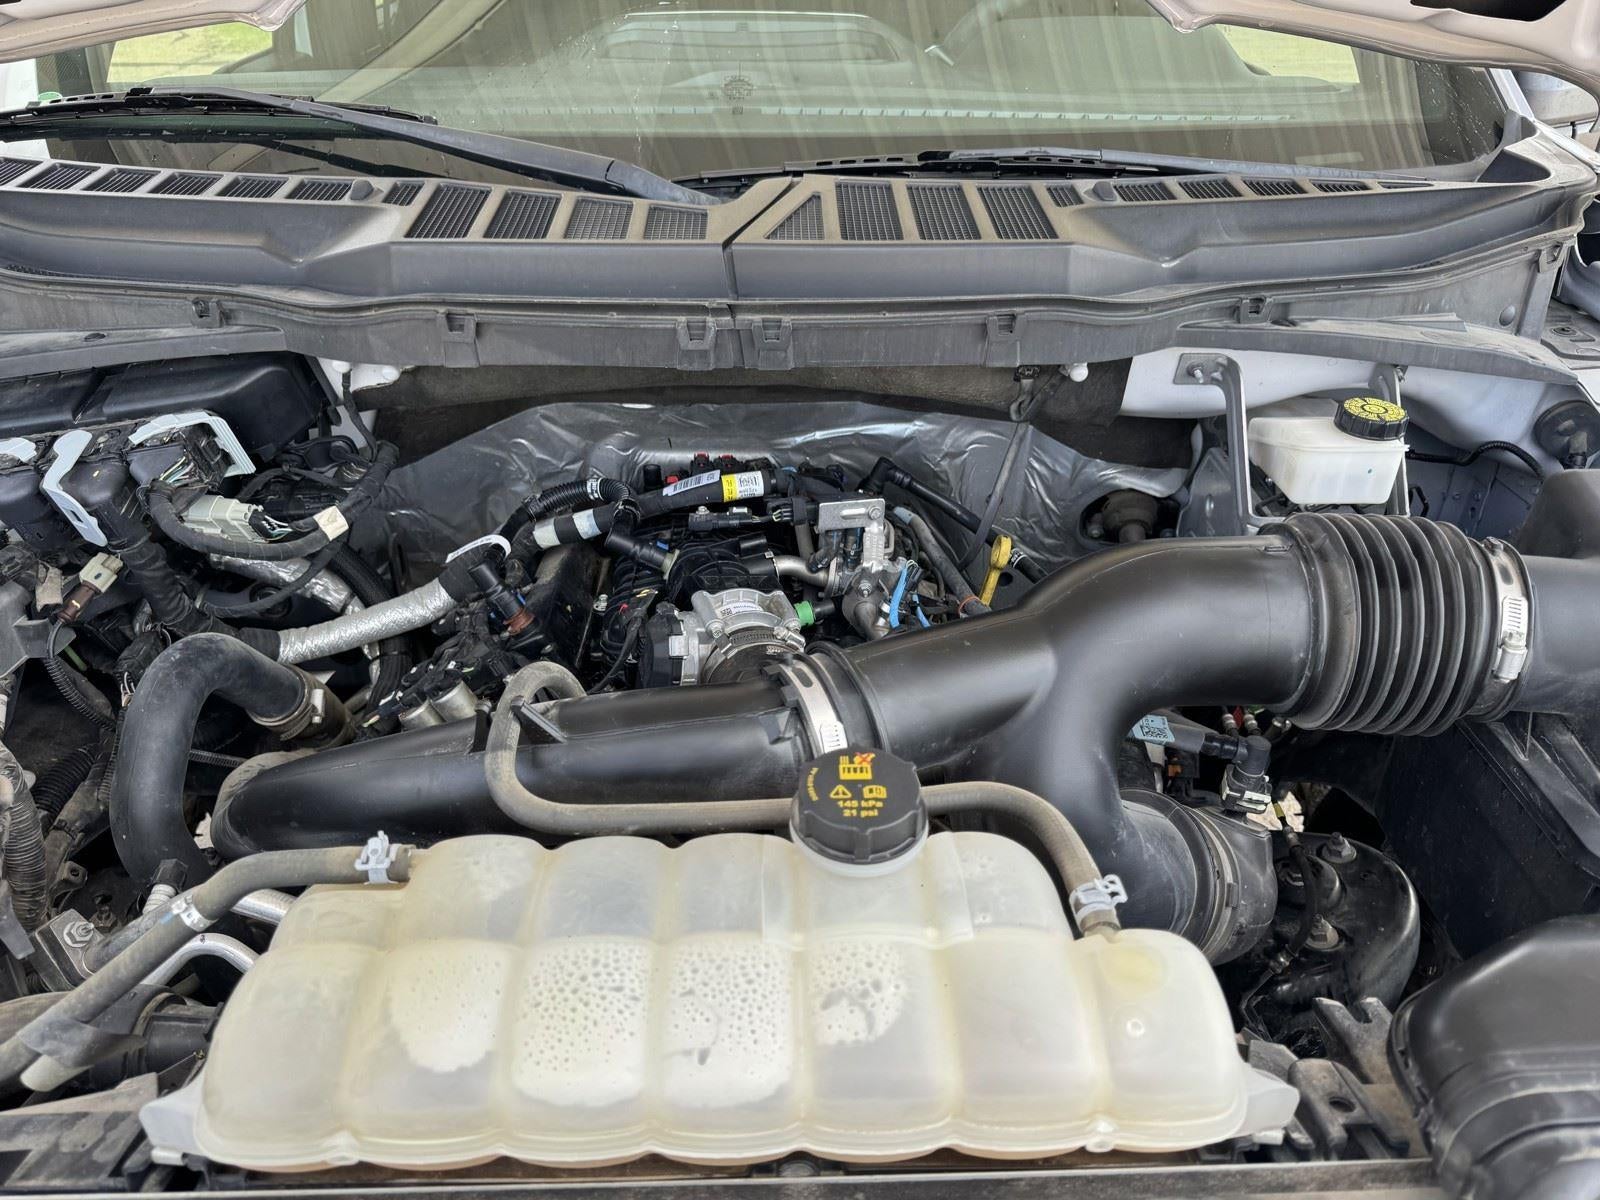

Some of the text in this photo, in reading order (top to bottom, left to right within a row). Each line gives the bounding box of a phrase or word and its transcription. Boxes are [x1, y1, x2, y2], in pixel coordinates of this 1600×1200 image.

[837, 800, 884, 808] 145 kPa
[843, 808, 879, 818] 21 psi
